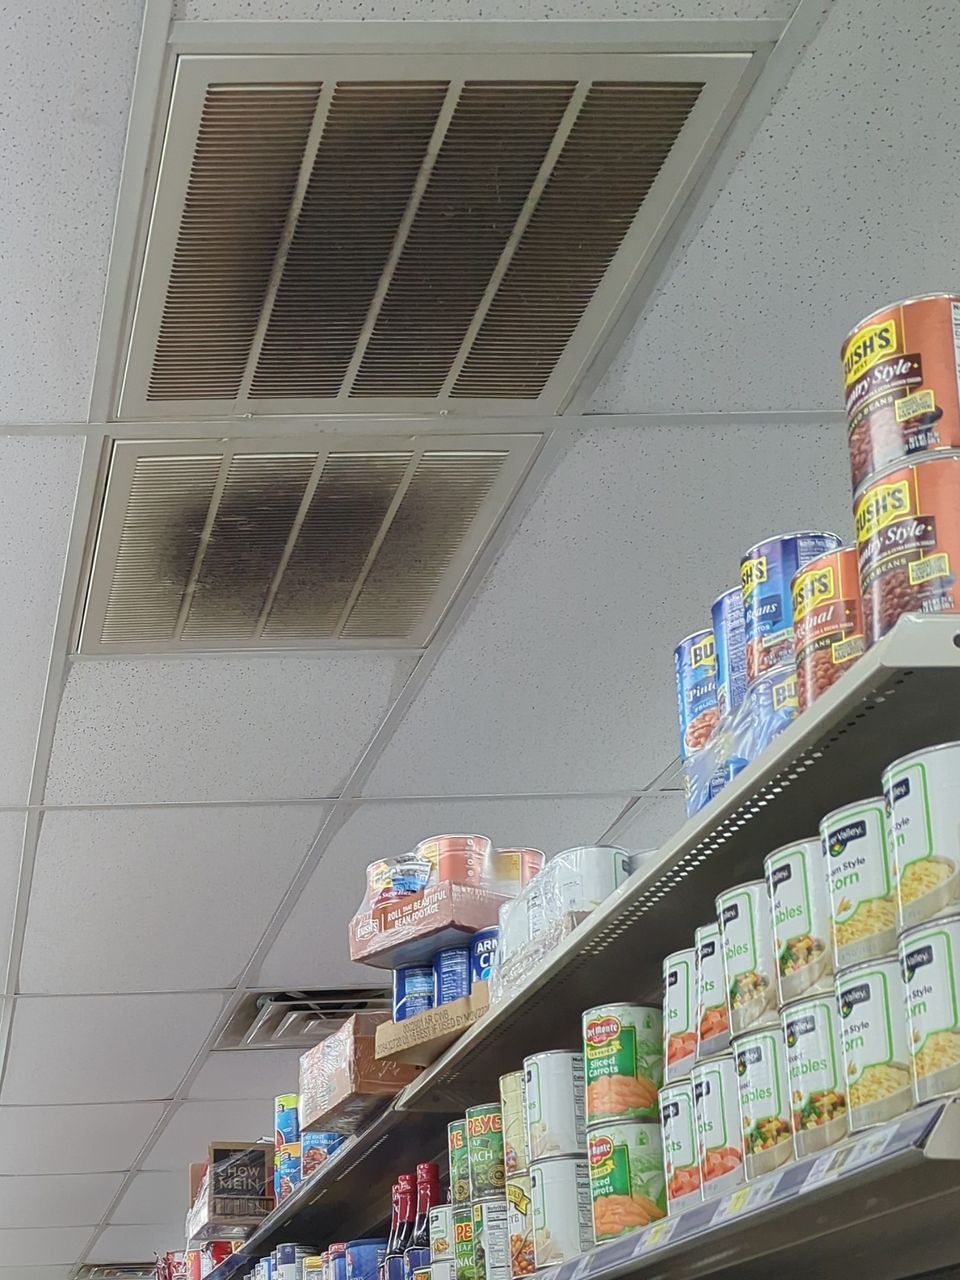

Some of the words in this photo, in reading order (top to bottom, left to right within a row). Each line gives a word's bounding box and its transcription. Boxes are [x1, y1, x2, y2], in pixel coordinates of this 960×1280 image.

[845, 327, 891, 373] USH'S
[872, 358, 913, 383] Style
[856, 487, 904, 537] USH'S
[885, 520, 926, 545] Style
[741, 560, 765, 588] SH'S
[795, 573, 829, 607] SH'S
[795, 605, 833, 641] iginal
[693, 642, 715, 662] BU
[690, 682, 716, 700] Pint
[774, 683, 797, 704] BU
[694, 700, 718, 714] FRIJO
[775, 905, 803, 925] ables
[477, 939, 497, 954] ARM
[589, 1066, 619, 1078] Carrots
[590, 1056, 616, 1068] Sliced
[790, 1060, 828, 1080] tables
[741, 1088, 772, 1104] tables
[470, 1149, 493, 1163] NACH
[218, 1167, 260, 1178] CHOW
[591, 1177, 610, 1188] liced
[219, 1178, 260, 1190] MEIN
